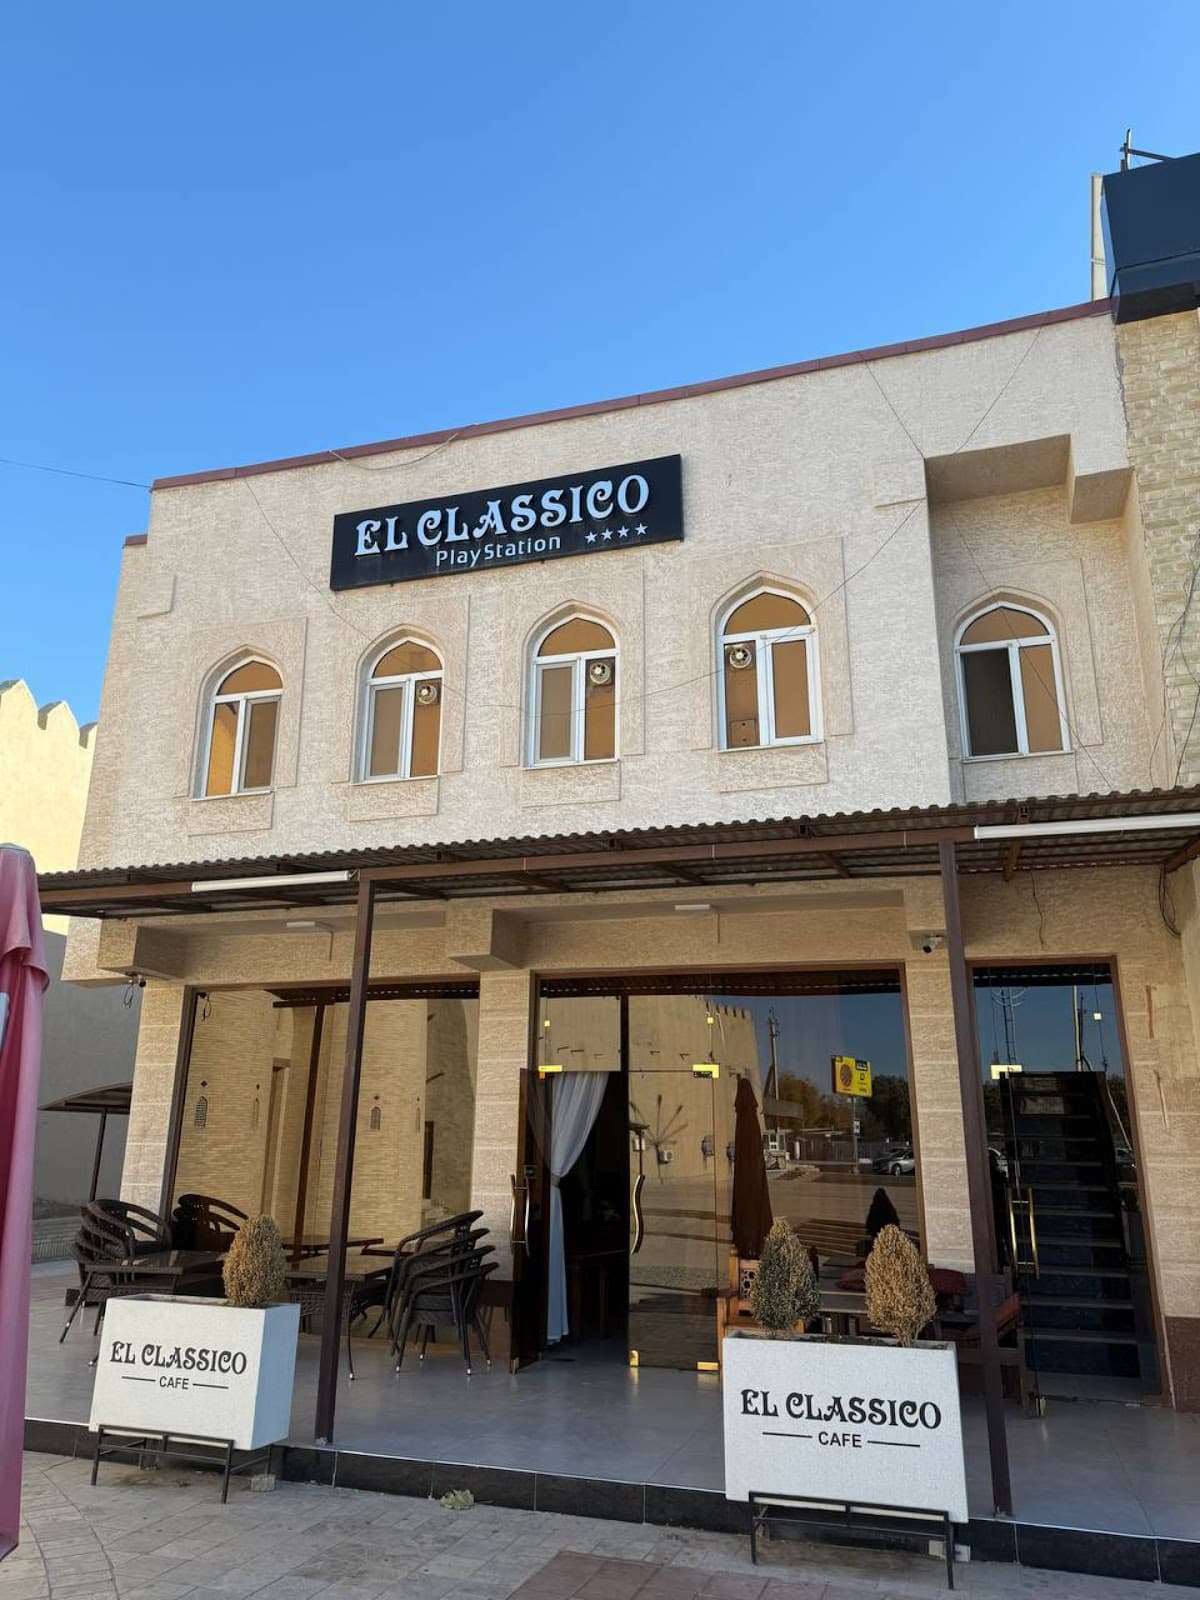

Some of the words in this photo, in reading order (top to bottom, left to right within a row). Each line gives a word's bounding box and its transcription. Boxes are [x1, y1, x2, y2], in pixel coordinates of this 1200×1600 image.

[354, 516, 409, 557] EL
[416, 474, 650, 546] CLASSICO
[110, 1341, 136, 1364] EL
[141, 1343, 247, 1375] CLASSICO
[159, 1376, 189, 1390] CAFE
[741, 1388, 778, 1416] EL
[786, 1392, 942, 1429] CLASSICO
[818, 1431, 862, 1448] CAFE
